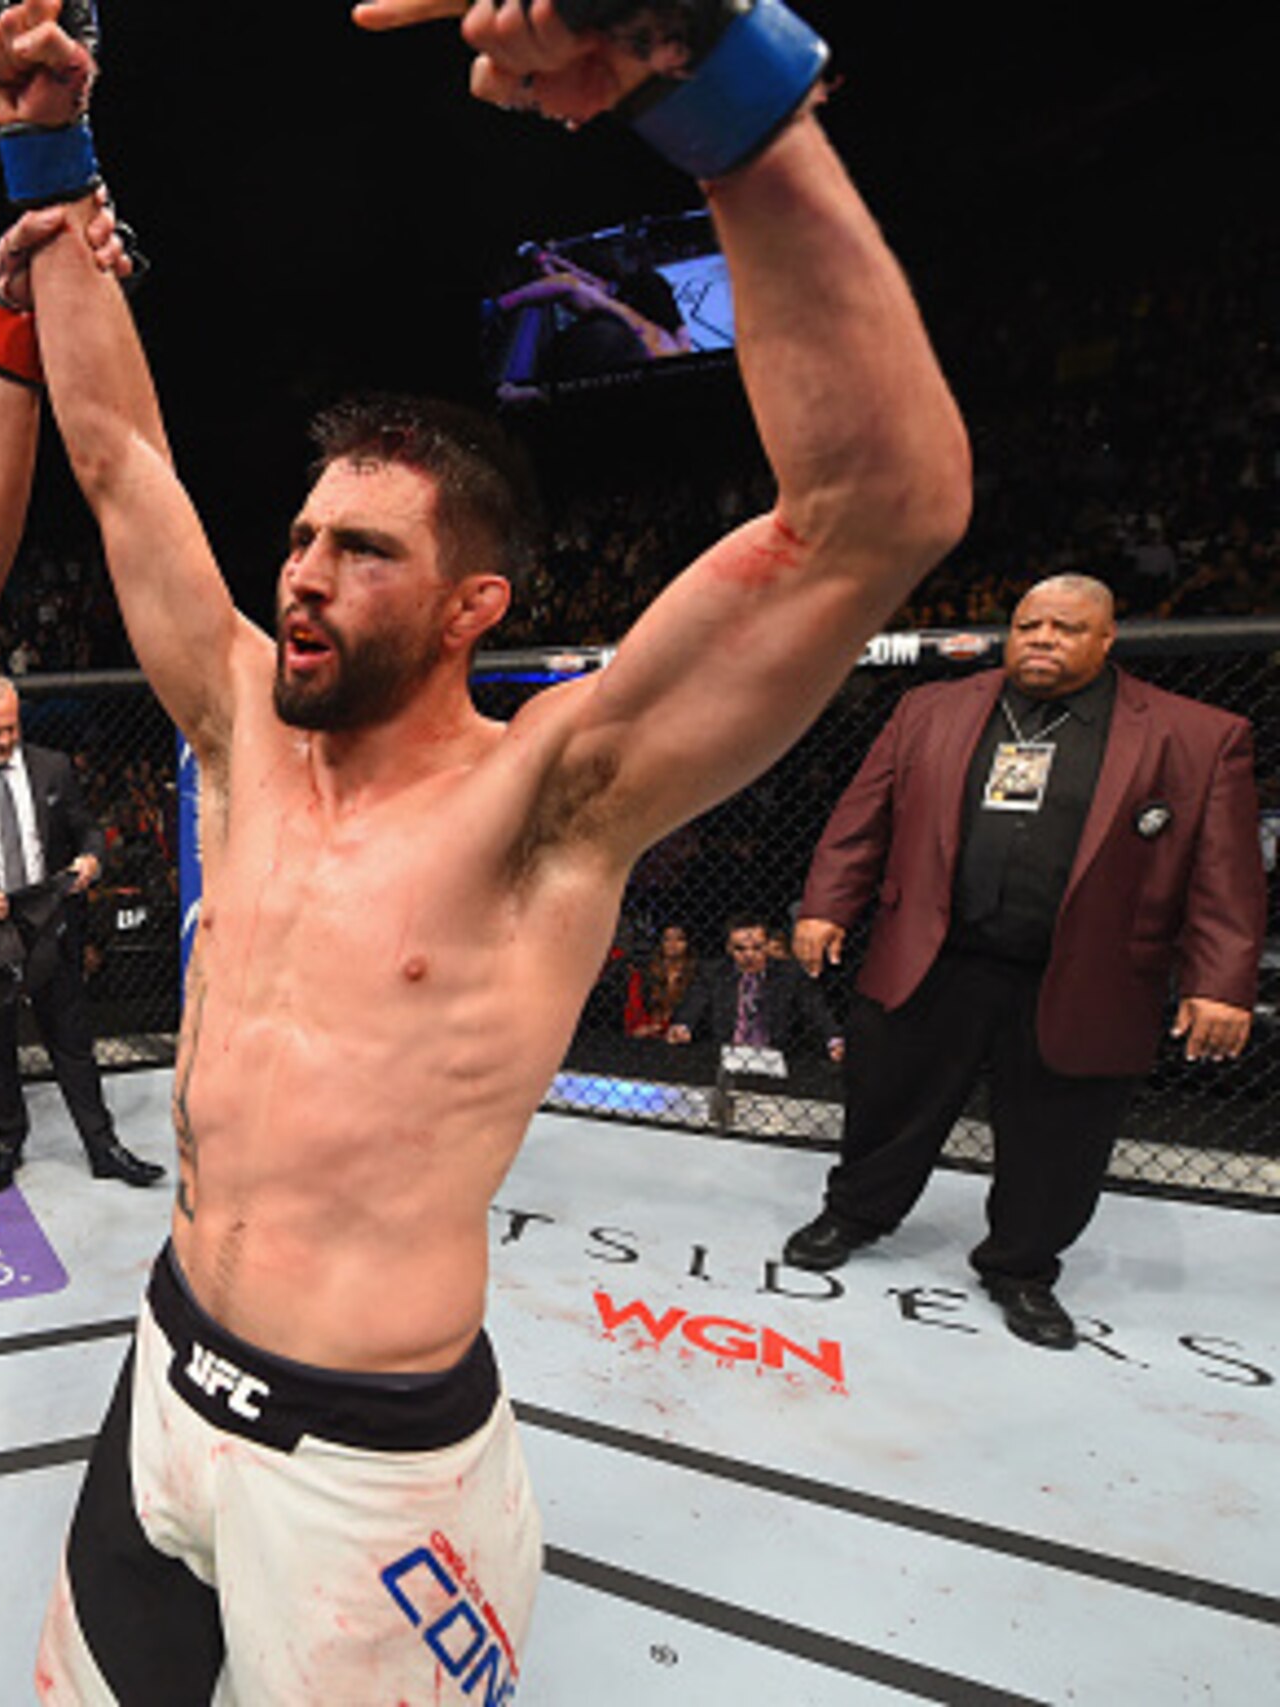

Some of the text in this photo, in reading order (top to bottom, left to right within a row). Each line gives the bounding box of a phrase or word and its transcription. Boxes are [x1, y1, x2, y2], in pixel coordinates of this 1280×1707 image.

[490, 1203, 1274, 1387] TSIDERS
[592, 1290, 846, 1383] WGN
[183, 1340, 270, 1421] UFC
[380, 1546, 517, 1707] CON
